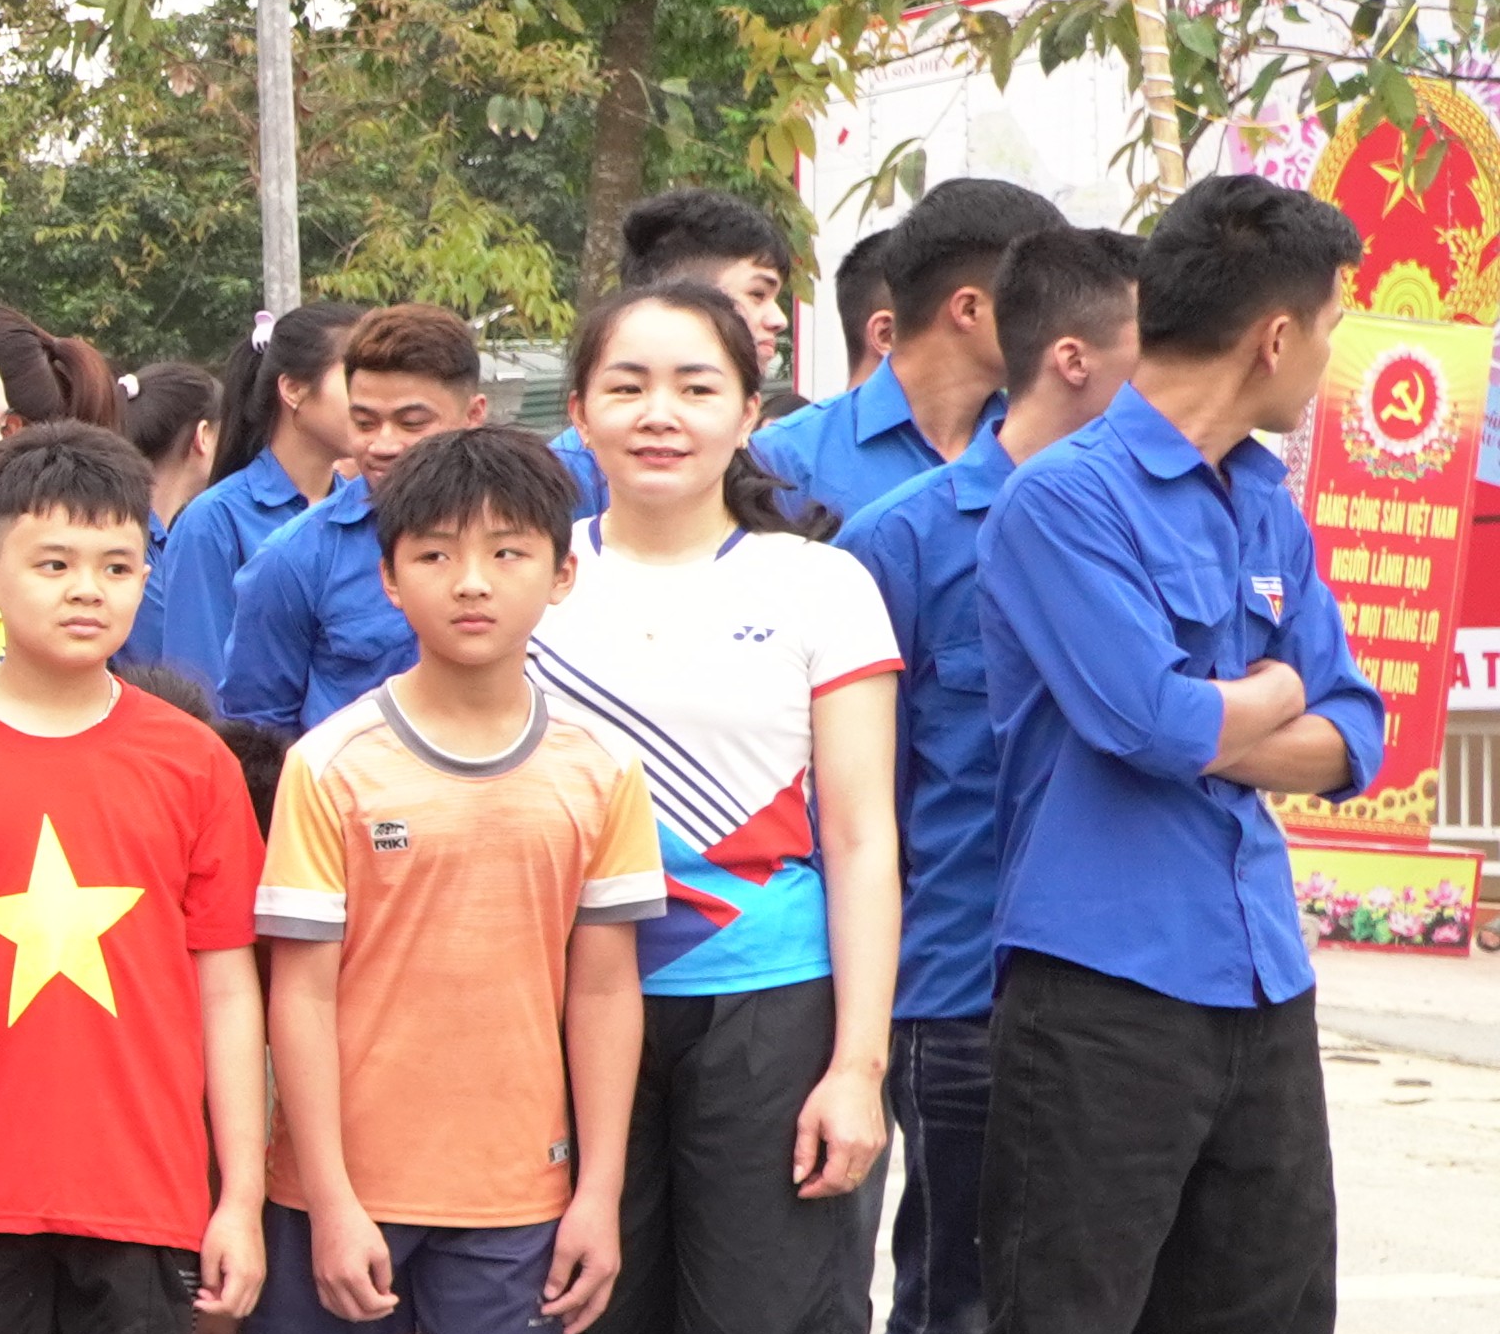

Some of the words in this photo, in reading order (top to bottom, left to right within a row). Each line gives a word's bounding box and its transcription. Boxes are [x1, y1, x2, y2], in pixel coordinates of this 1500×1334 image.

[1315, 479, 1349, 529] ĐẢNG
[1349, 489, 1381, 537] CỘNG
[1381, 487, 1406, 535] SẢN
[1406, 496, 1432, 544] VIỆT
[1430, 505, 1459, 540] NAM
[1330, 541, 1370, 584] NGƯỜI
[1370, 546, 1405, 588] LÃNH
[1404, 555, 1432, 597] ĐẠO
[1357, 603, 1382, 646] MỌI
[1419, 608, 1440, 652] LỢI
[1380, 658, 1419, 701] MẠNG
[375, 837, 408, 850] RIKI
